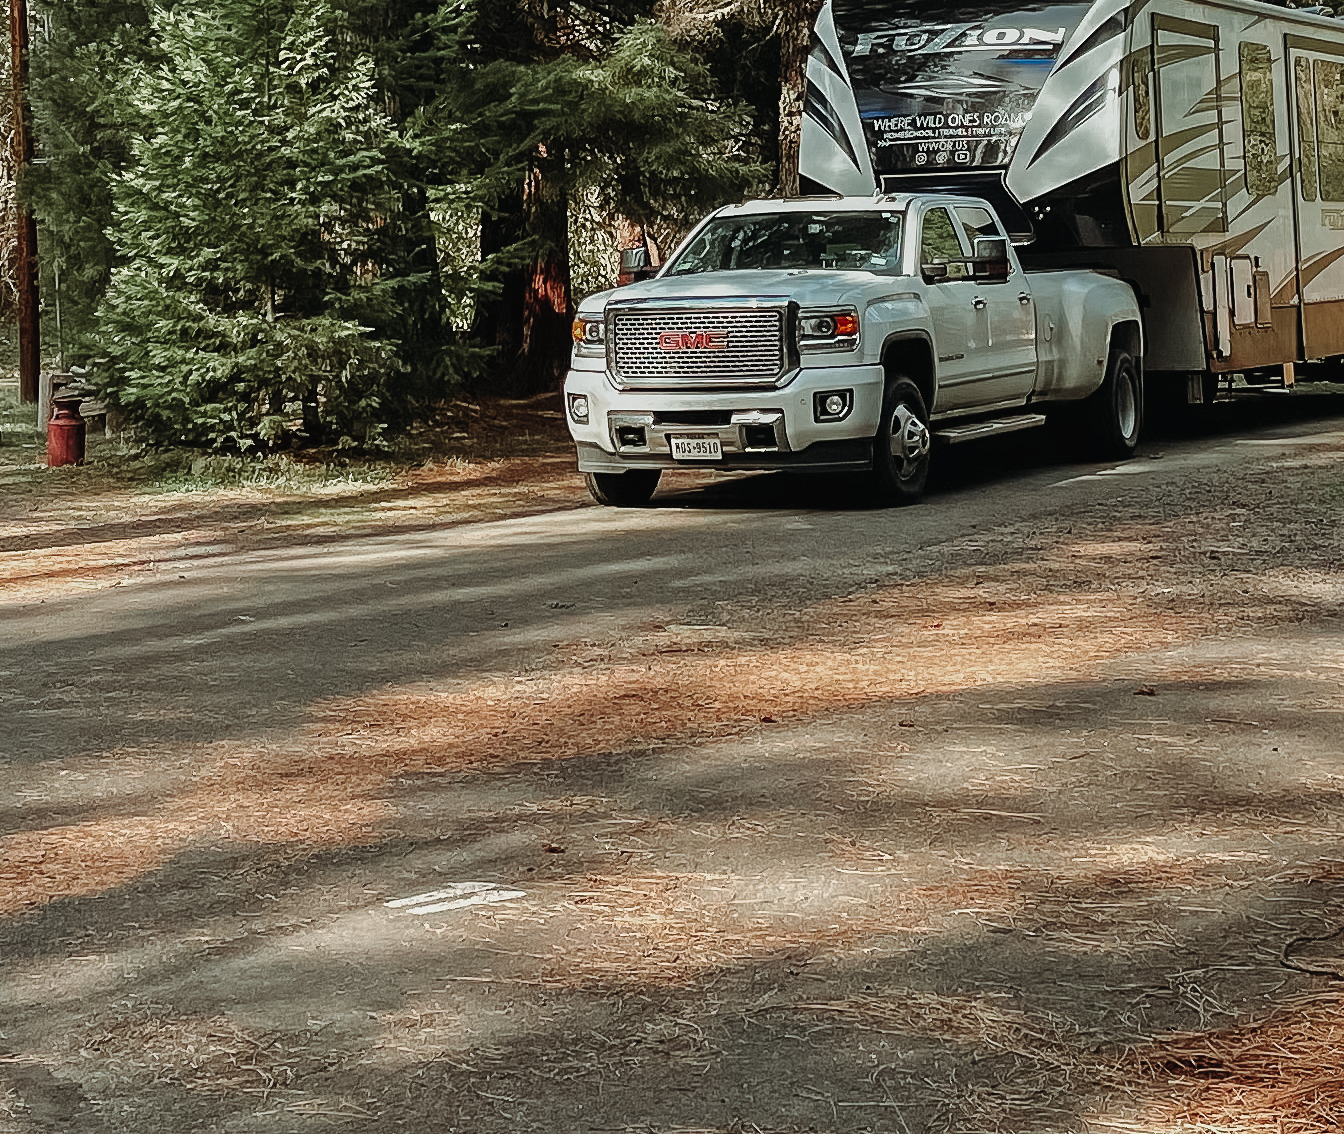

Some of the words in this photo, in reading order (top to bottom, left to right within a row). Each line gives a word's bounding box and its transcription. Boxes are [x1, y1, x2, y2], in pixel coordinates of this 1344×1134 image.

[873, 116, 913, 131] WHERE
[916, 114, 944, 128] WILD
[948, 113, 980, 126] ONES
[983, 112, 1023, 126] ROAM
[939, 128, 967, 136] TRAVEL
[659, 331, 728, 350] GMC
